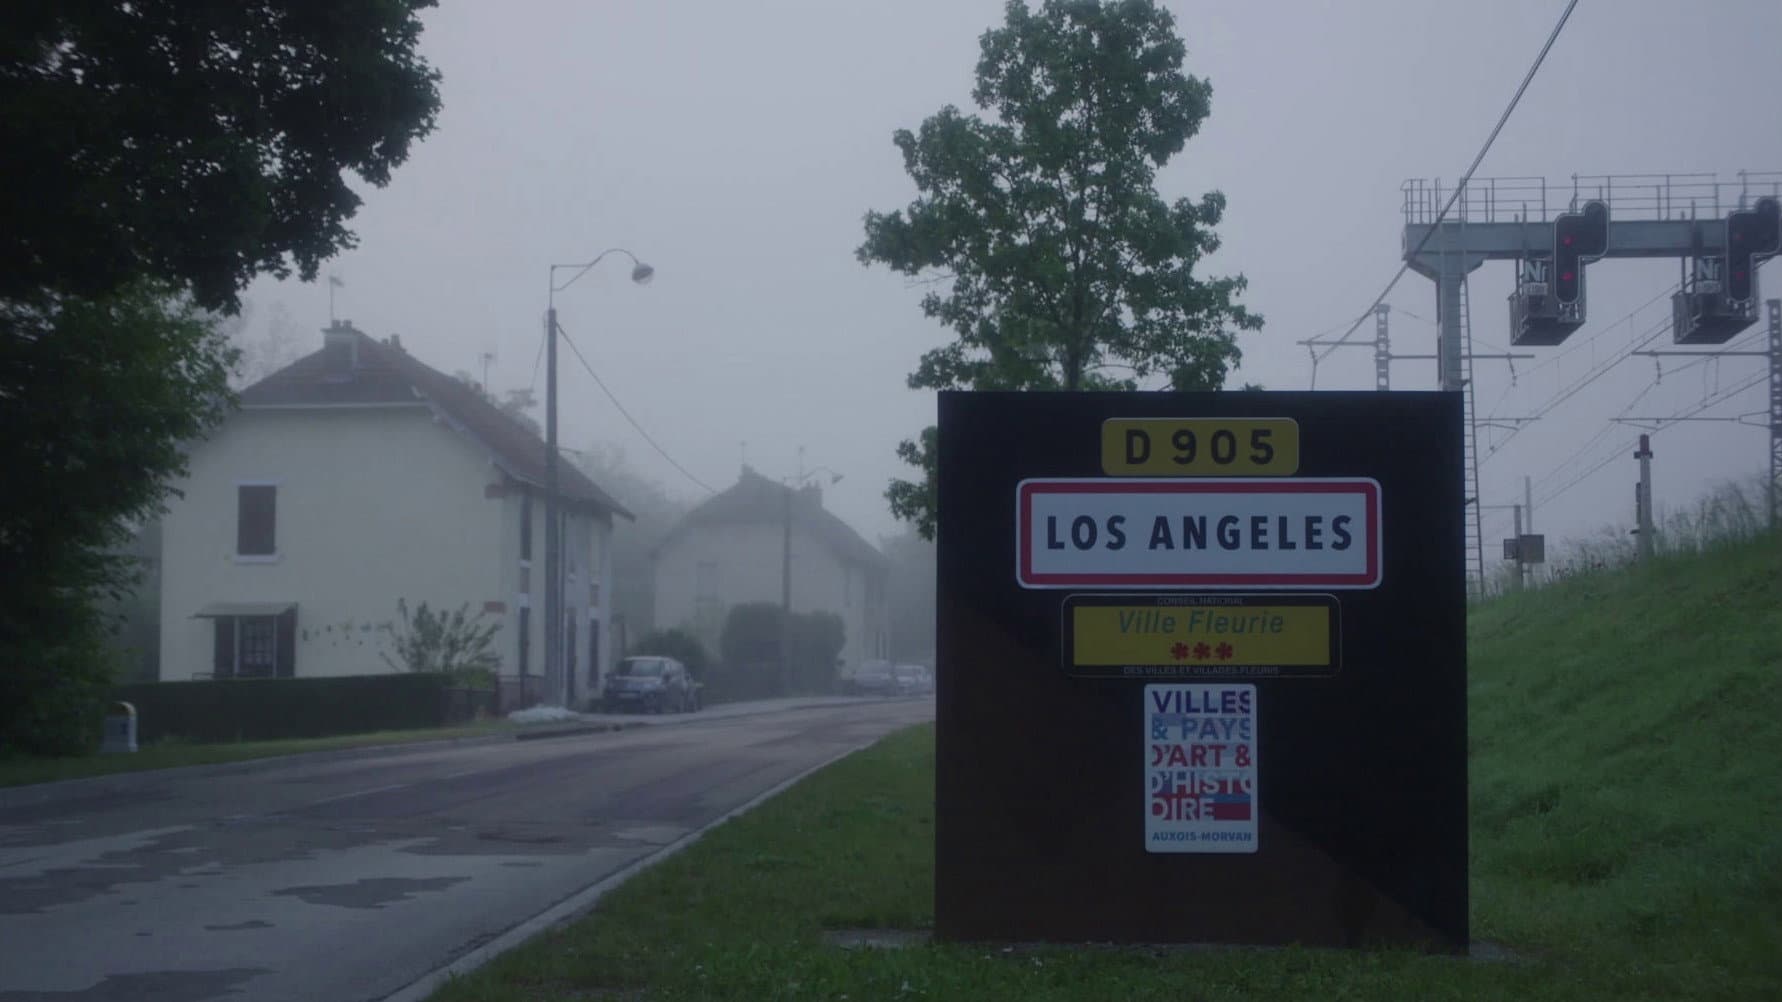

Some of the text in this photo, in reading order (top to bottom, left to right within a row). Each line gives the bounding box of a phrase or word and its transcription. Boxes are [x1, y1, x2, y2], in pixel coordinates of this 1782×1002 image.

[1125, 429, 1275, 466] D 905
[1046, 515, 1353, 551] LOS ANGELES
[1119, 610, 1284, 634] Ville Fleurie
[1152, 690, 1250, 714] VILLES
[1181, 717, 1251, 740] PAYS
[1235, 744, 1251, 768] &
[1152, 831, 1252, 842] AUXOIS-MORVAN
